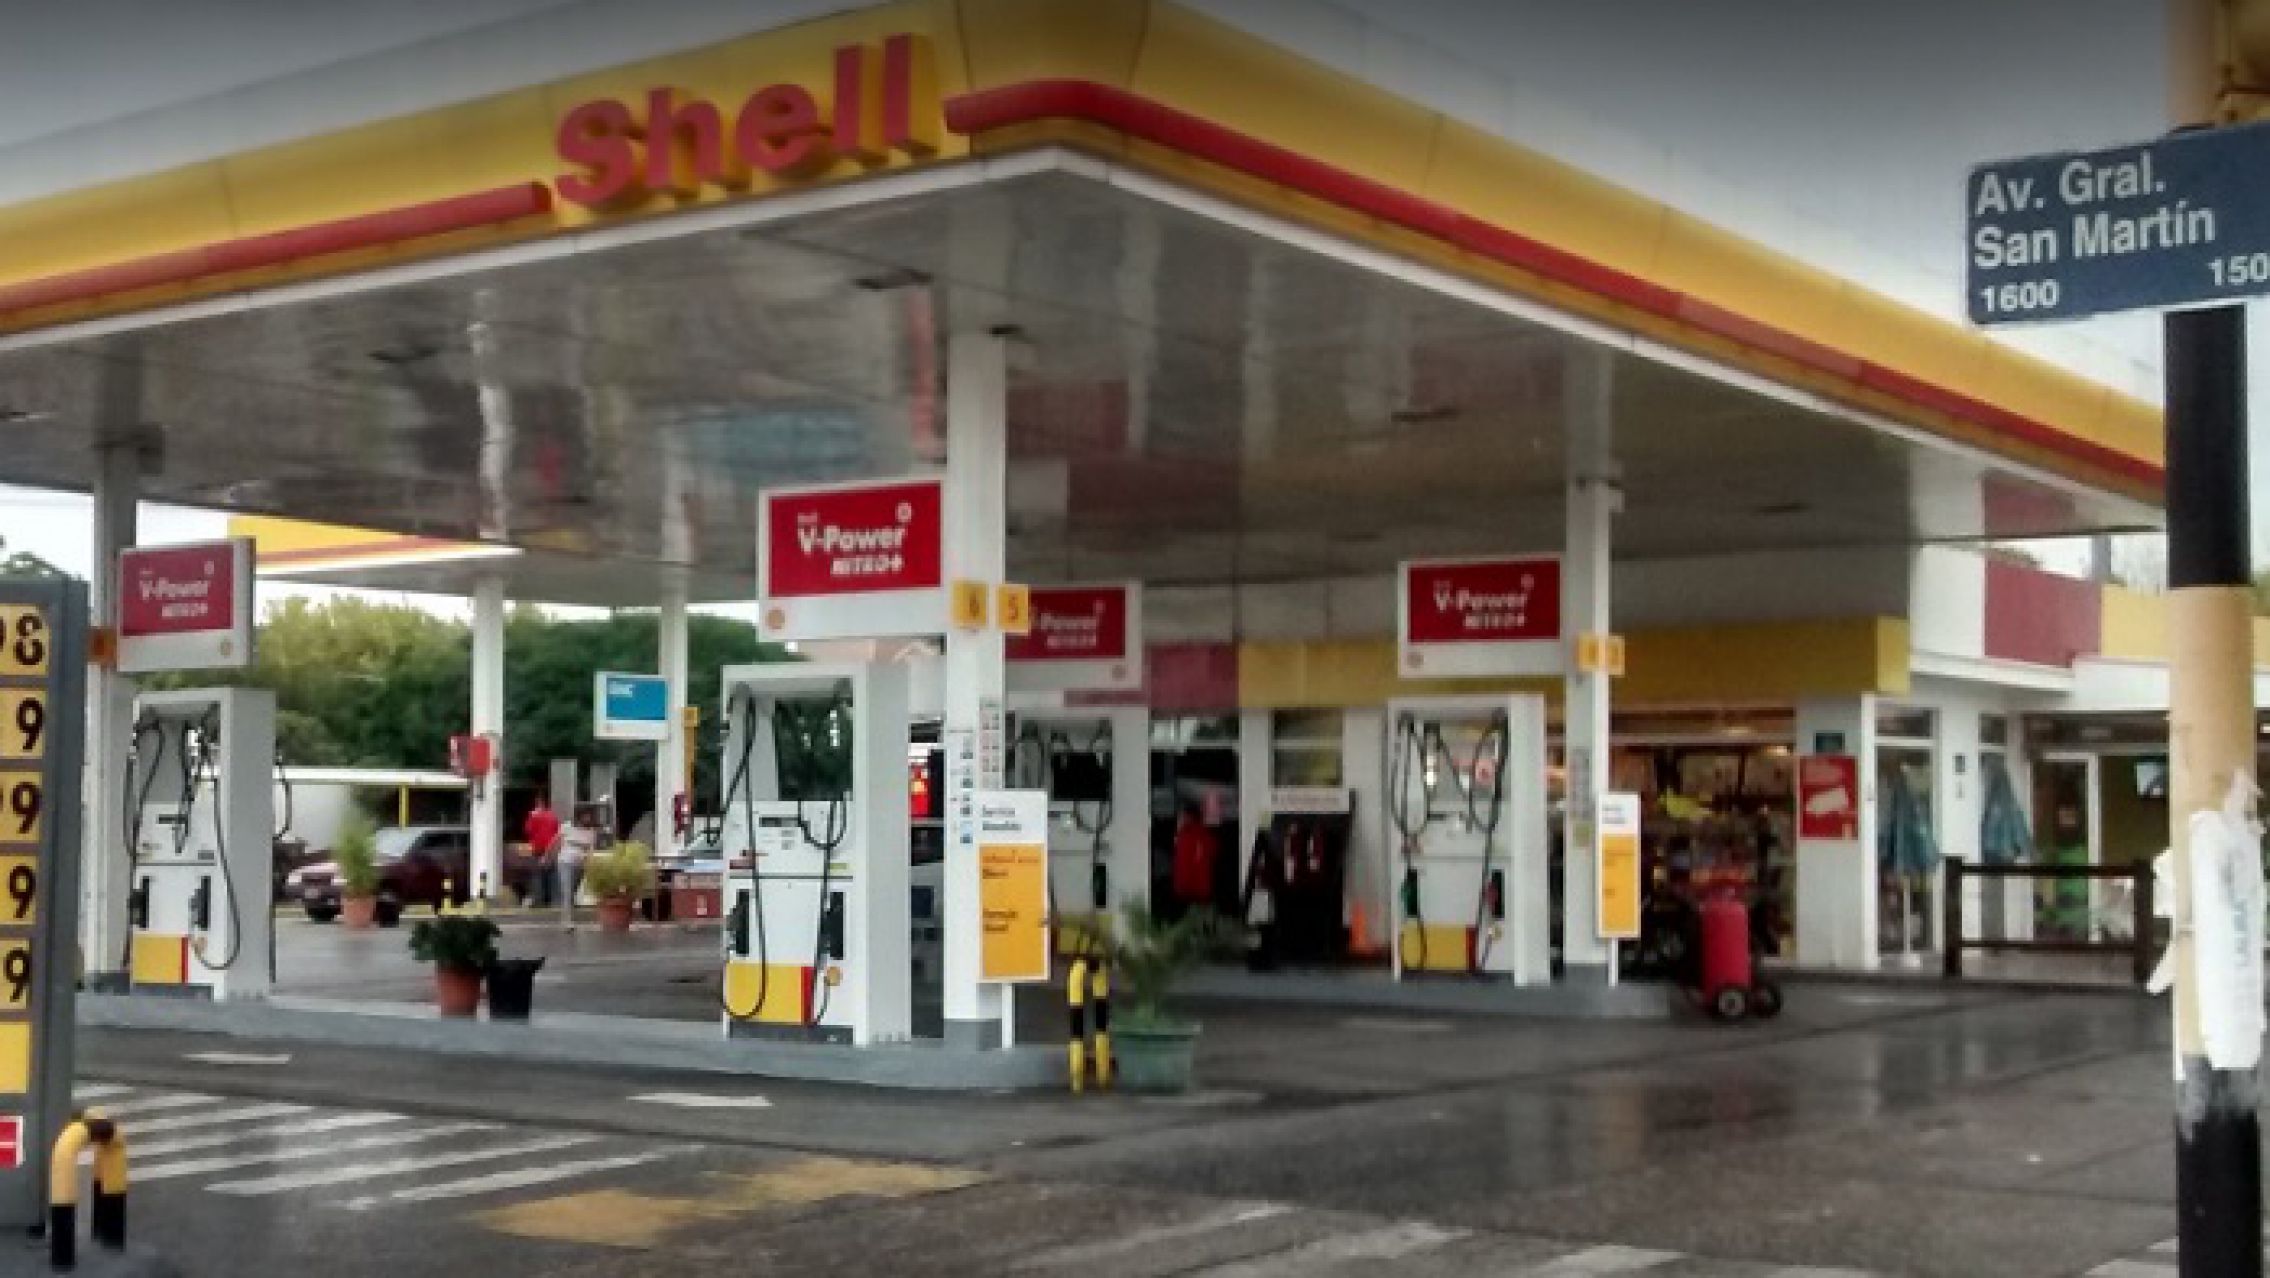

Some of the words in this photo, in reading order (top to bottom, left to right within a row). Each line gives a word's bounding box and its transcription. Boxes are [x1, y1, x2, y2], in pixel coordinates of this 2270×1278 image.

[555, 33, 913, 208] Shell
[1975, 171, 2045, 216] Av.
[2059, 150, 2166, 205] Gral.
[1974, 225, 2058, 269] San
[2071, 199, 2216, 258] Martín
[1980, 278, 2060, 312] 1600
[797, 524, 908, 555] V-Power
[0, 612, 44, 666] 8
